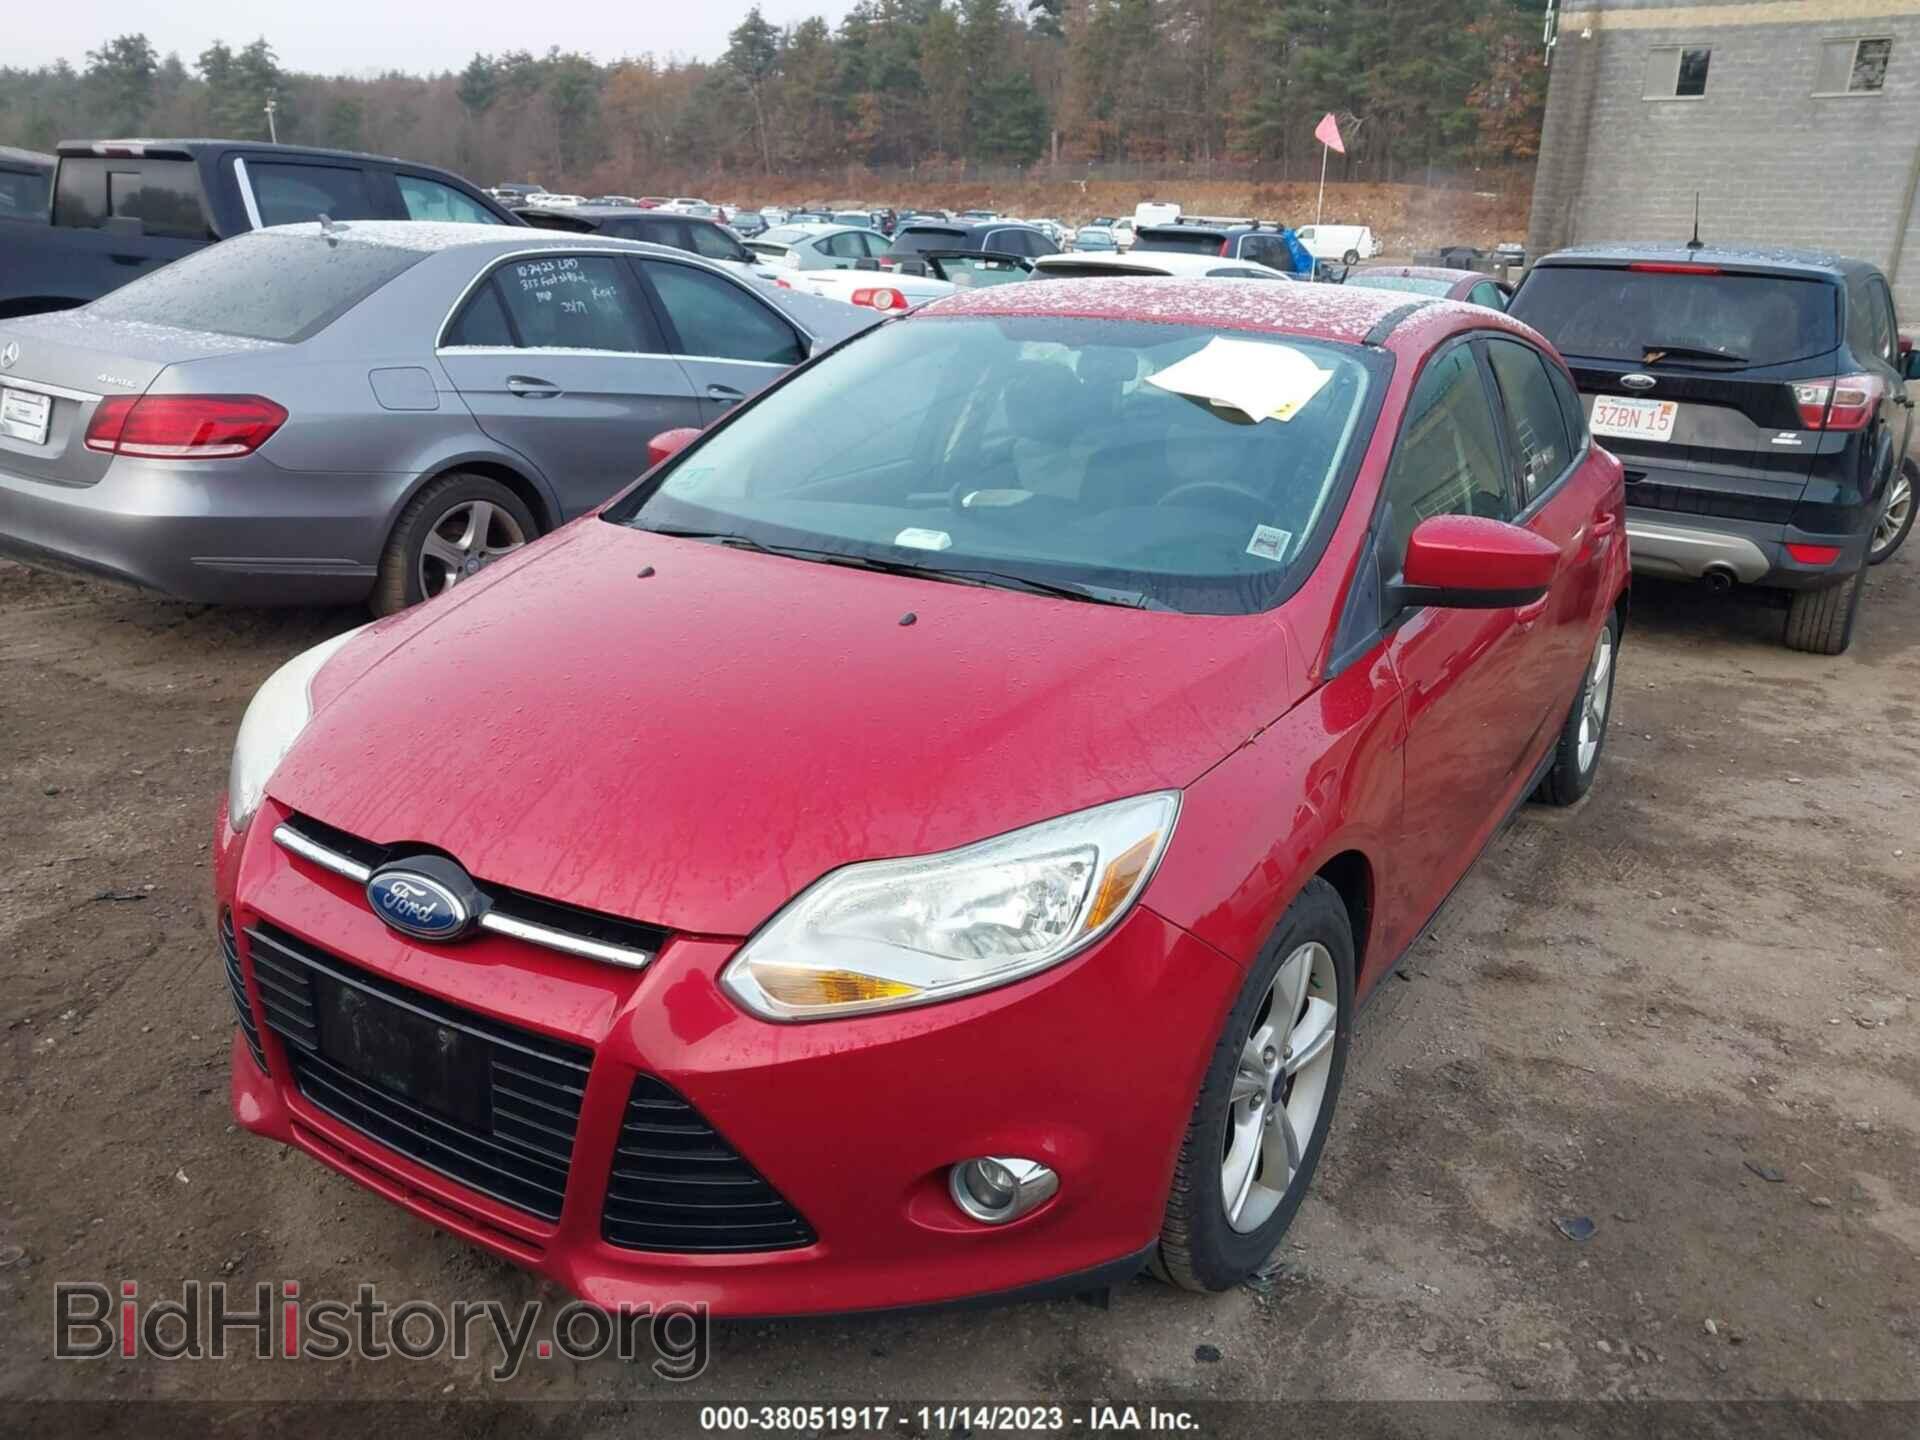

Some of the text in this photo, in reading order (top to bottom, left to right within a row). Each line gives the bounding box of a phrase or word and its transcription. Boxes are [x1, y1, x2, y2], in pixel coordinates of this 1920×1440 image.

[1595, 406, 1670, 431] 3ZBN 15
[383, 881, 438, 922] Ford
